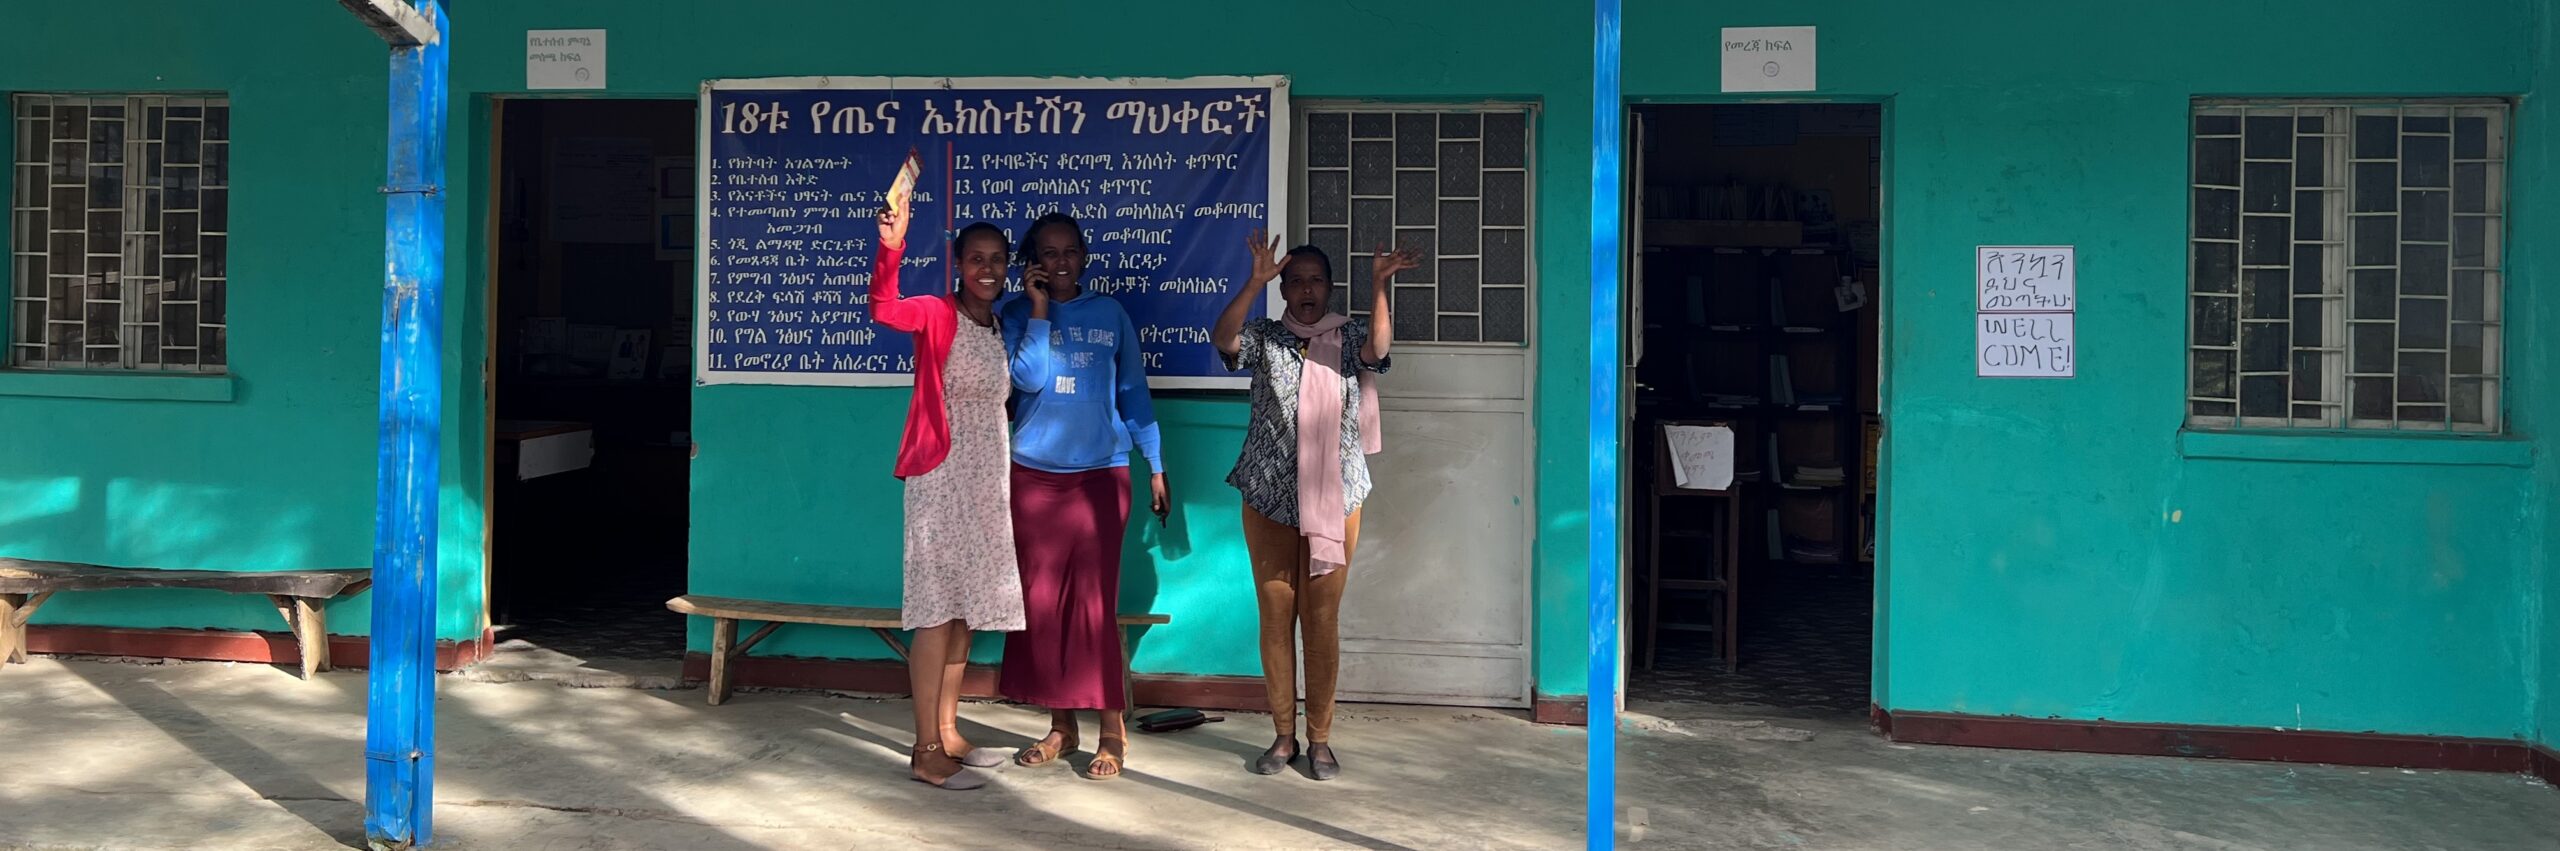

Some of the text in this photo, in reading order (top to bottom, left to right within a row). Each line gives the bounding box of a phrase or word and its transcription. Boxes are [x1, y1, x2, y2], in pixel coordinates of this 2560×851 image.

[1725, 39, 1761, 52] የመረጃ
[721, 94, 1266, 135] 18ቱ የጤና ኤክስቴሽን ማህቀፎች
[711, 156, 852, 169] 1. የክትባት አገልግሎት
[954, 154, 974, 170] 12.
[1057, 154, 1113, 171] ቆርጣሚ
[1185, 154, 1237, 170] ቁጥጥር
[710, 175, 721, 185] 2.
[785, 173, 819, 185] እቅድ
[954, 178, 1152, 195] 13. የወባ መከላከልና ቁጥጥር
[710, 190, 721, 201] 3.
[728, 189, 786, 201] የእናቶችና
[840, 191, 865, 201] ጤና
[710, 207, 721, 217] 4.
[728, 207, 796, 218] የተመጣጠነ
[803, 207, 840, 218] ምግብ
[954, 204, 974, 219] 14.
[982, 201, 1017, 219] የኤች
[1070, 203, 1107, 219] ኤድስ
[1115, 203, 1185, 220] መከላከልና
[767, 223, 822, 234] አመጋገብ
[1102, 227, 1172, 244] መቆጣጠር
[710, 238, 867, 251] 5. ጎጂ ልማዳዊ ድርጊቶች
[710, 256, 720, 266] 6.
[727, 255, 779, 266] የመጸዳጃ
[785, 254, 809, 266] ቤት
[1119, 252, 1167, 270] እርዳታ
[710, 273, 720, 284] 7.
[727, 273, 771, 285] የምግብ
[1090, 276, 1228, 295] በሽታዎች መከላከልና
[709, 292, 720, 303] 8.
[727, 290, 765, 303] የደረቅ
[772, 290, 804, 303] ፍሳሽ
[811, 290, 842, 303] ቆሻሻ
[709, 310, 720, 322] 9.
[727, 310, 760, 322] የውሃ
[811, 309, 862, 324] አያያዝና
[709, 328, 727, 343] 10.
[734, 328, 767, 344] የግል
[821, 327, 876, 345] አጠባበቅ
[1140, 324, 1211, 345] የትሮፒካል
[1985, 318, 2064, 342] WELL
[709, 353, 727, 369] 11.
[734, 352, 792, 371] የመኖሪያ
[800, 351, 825, 370] ቤት
[1984, 344, 2071, 372] COME!
